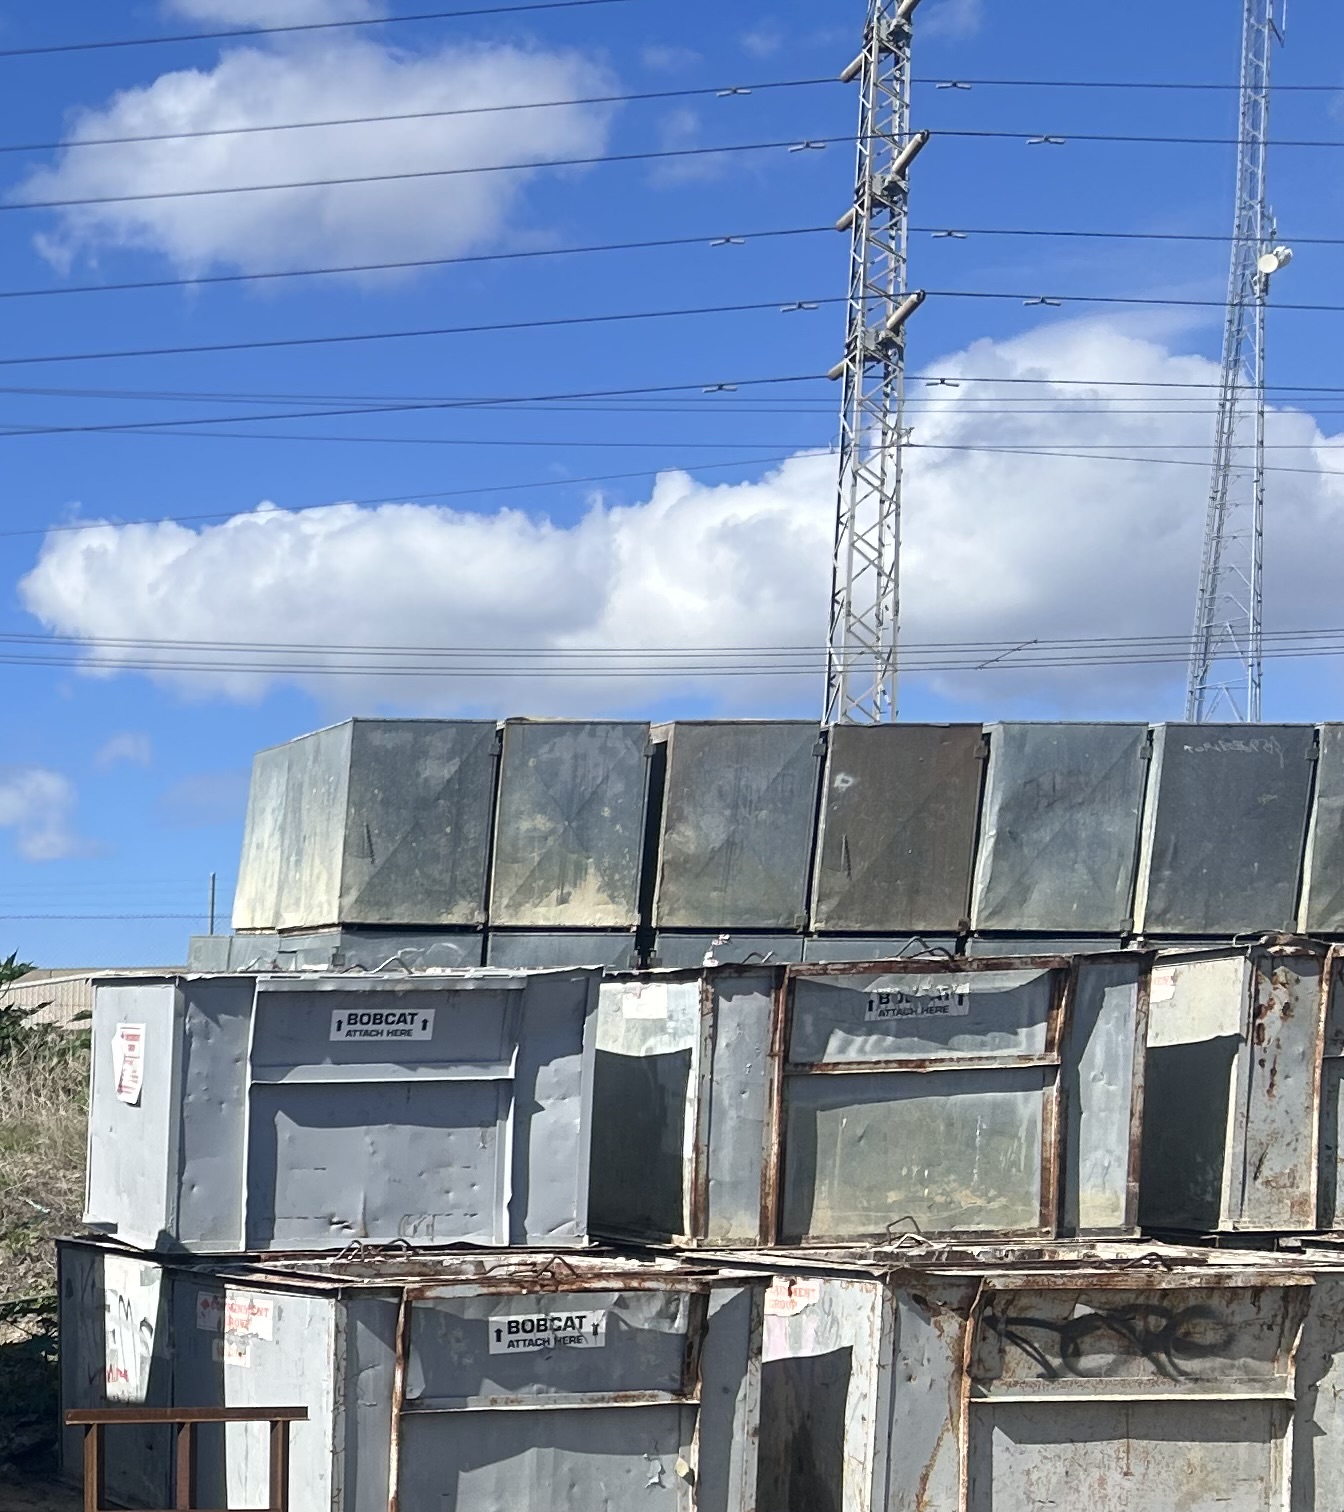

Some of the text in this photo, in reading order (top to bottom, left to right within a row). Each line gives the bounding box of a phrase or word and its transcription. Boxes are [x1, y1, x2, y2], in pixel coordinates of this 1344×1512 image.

[922, 1005, 950, 1014] HERE
[347, 1012, 419, 1026] BOBCAT
[345, 1028, 414, 1038] ATTACH HERE
[507, 1315, 587, 1335] BOBCAT
[507, 1335, 584, 1349] ATTACH HERE
